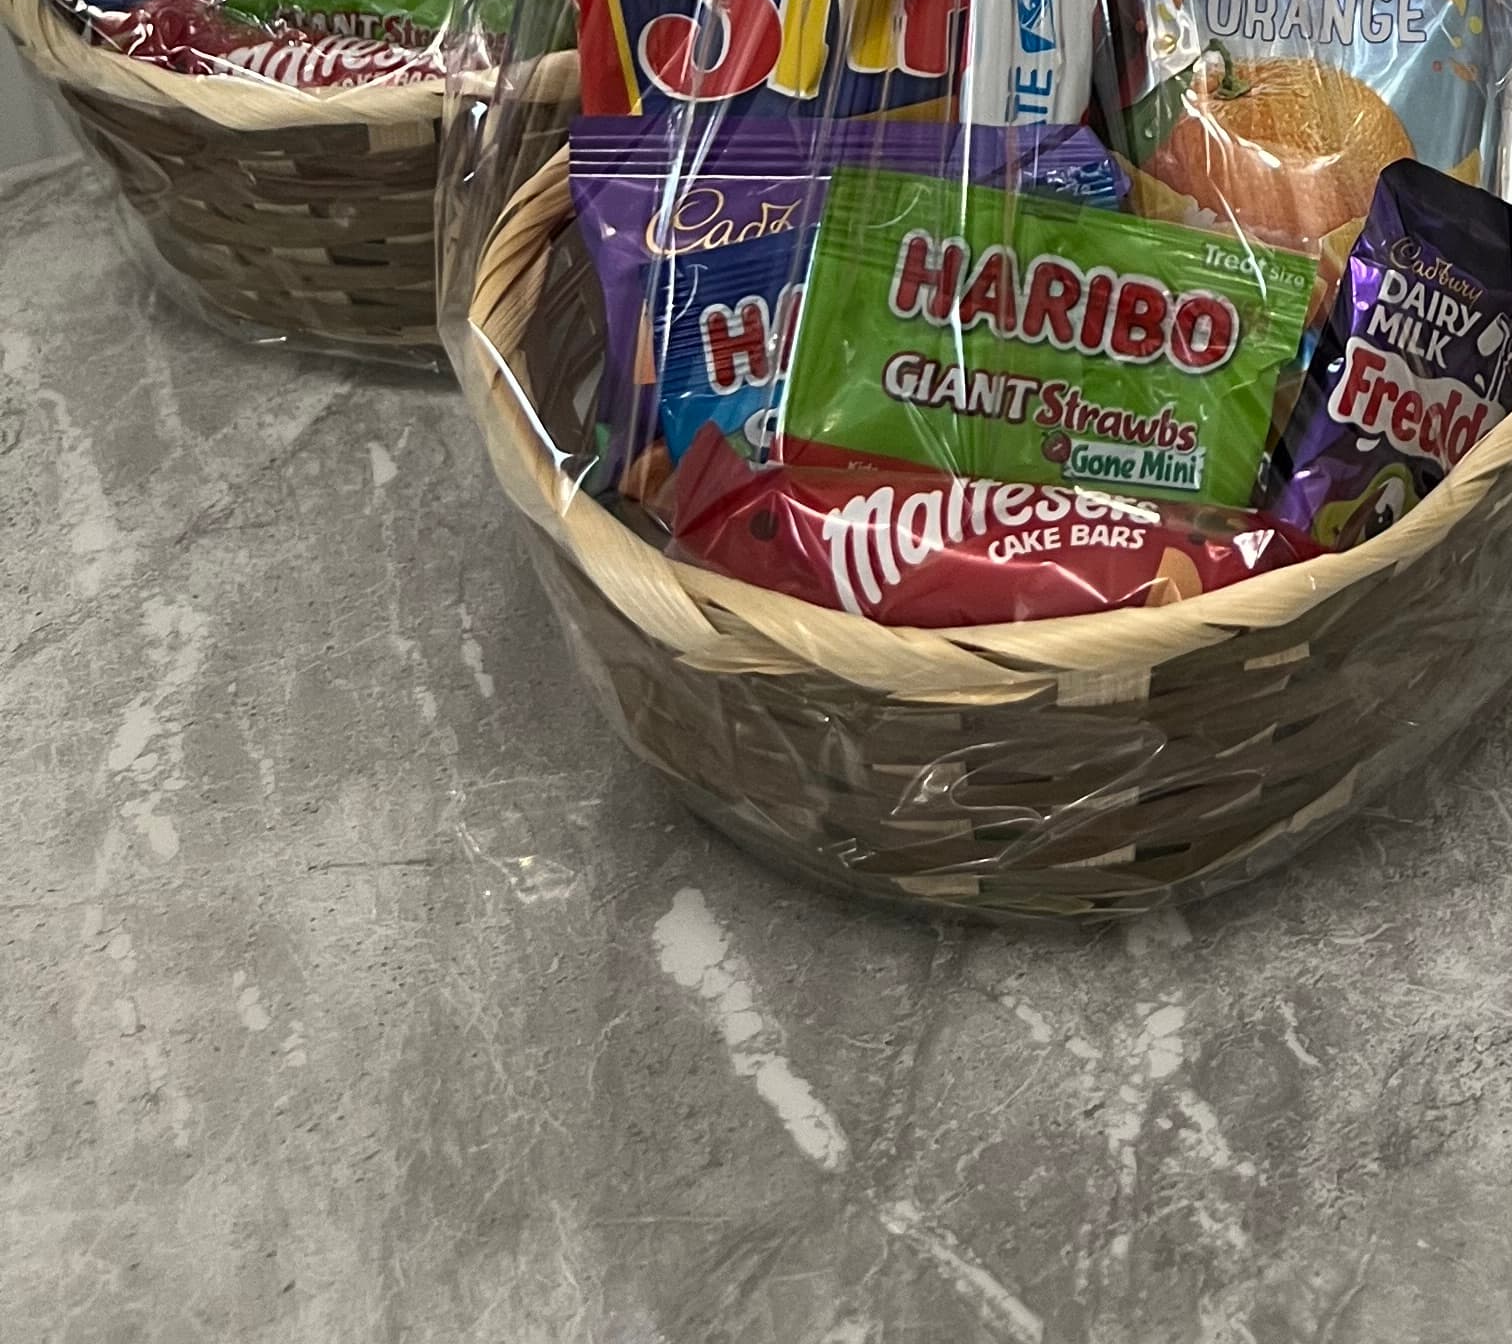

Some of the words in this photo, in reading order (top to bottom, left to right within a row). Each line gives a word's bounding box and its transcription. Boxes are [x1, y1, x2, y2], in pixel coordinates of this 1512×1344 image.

[1204, 242, 1268, 278] Treat
[1389, 236, 1485, 303] Cadbury
[889, 228, 1240, 375] HARIBO
[1378, 269, 1483, 338] DAIRY
[1366, 304, 1452, 369] MILK
[883, 351, 1040, 425] GIANT
[1033, 379, 1200, 455] Strawbs
[1337, 345, 1492, 464] Fredd
[1069, 443, 1134, 480] Gone
[1139, 447, 1197, 484] Mini
[822, 476, 1161, 617] Maltesers
[988, 527, 1062, 564] CAKE
[1069, 523, 1147, 549] BARS
